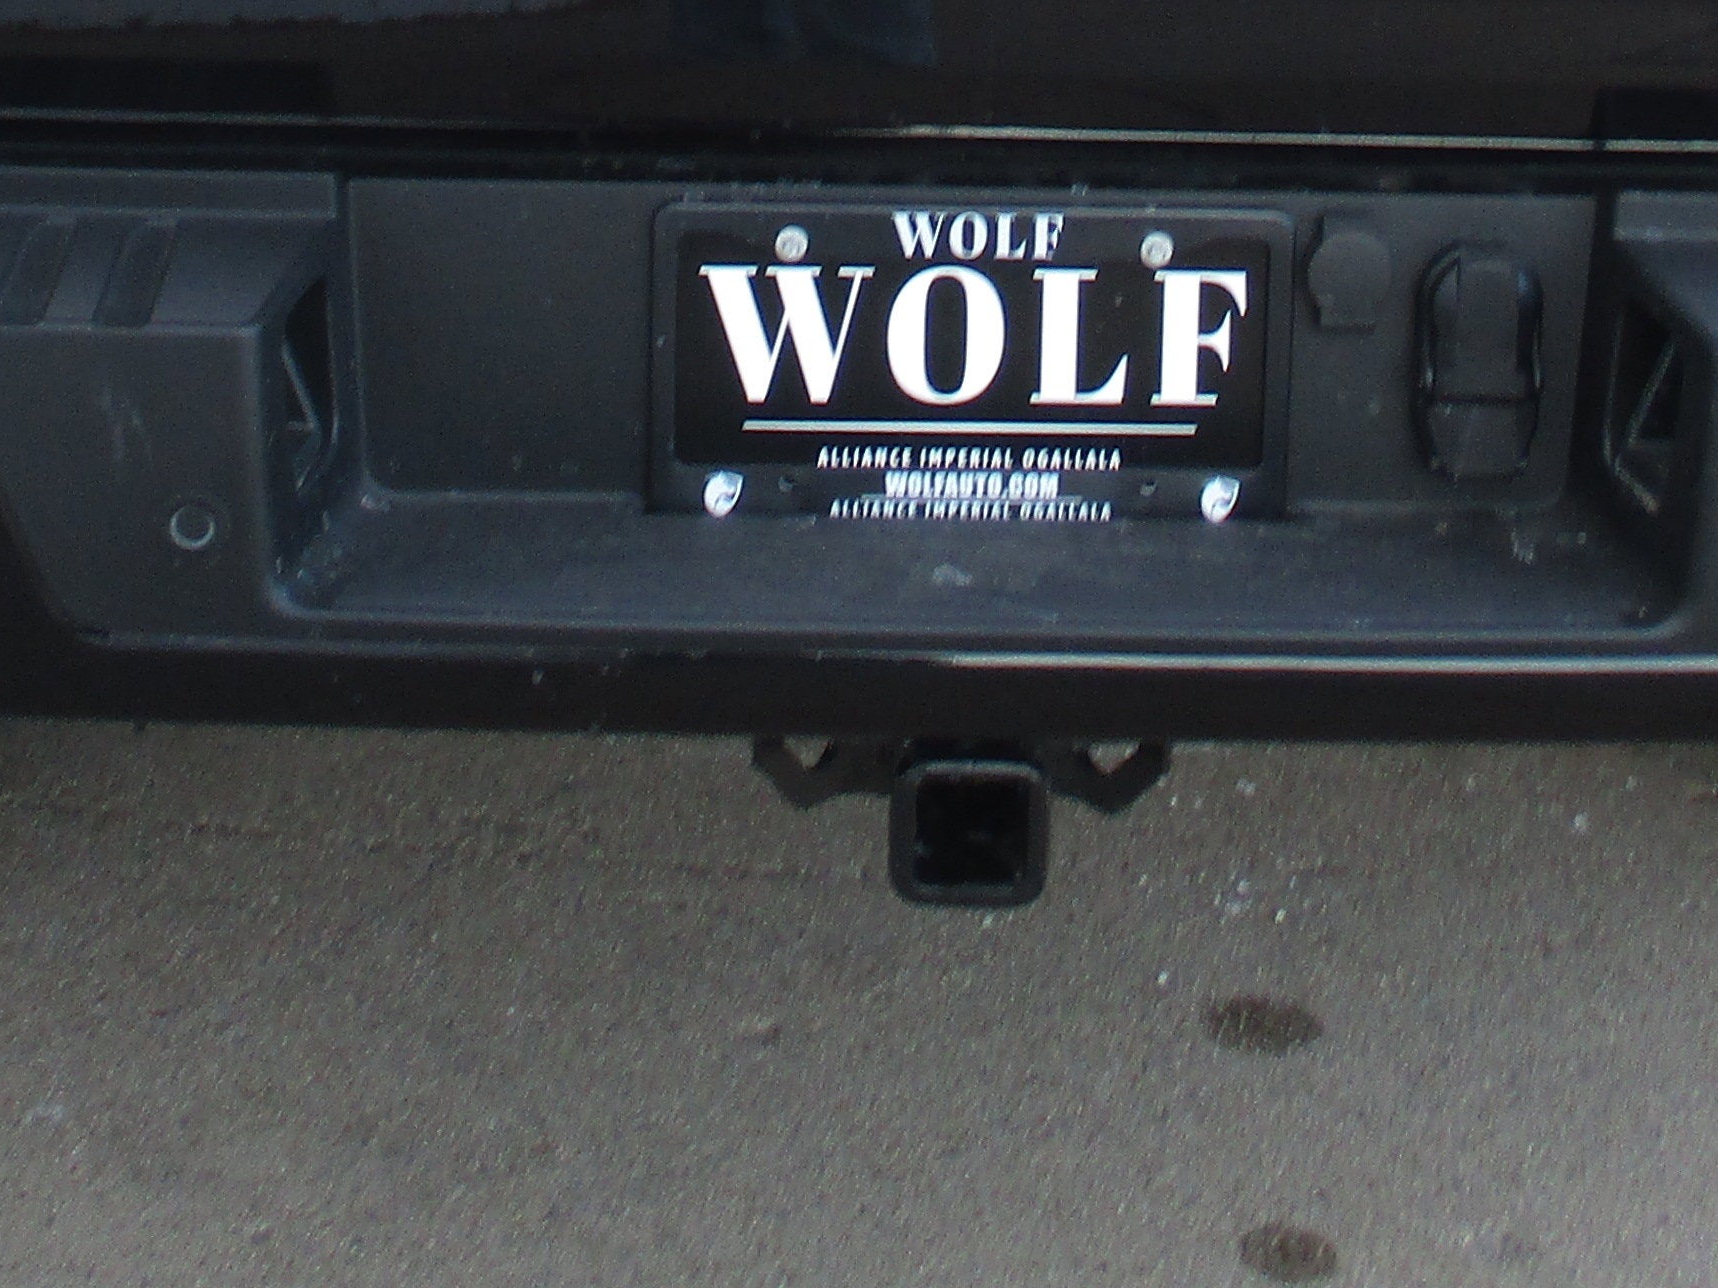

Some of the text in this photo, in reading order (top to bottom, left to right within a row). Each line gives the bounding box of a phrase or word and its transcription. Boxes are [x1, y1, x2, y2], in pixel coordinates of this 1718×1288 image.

[892, 210, 1066, 260] WOLF
[698, 264, 1248, 406] WOLF
[817, 445, 1122, 471] ALLIANCE IMPERIAL OGALLALA
[884, 471, 1061, 500] WOLFAUTO.COM
